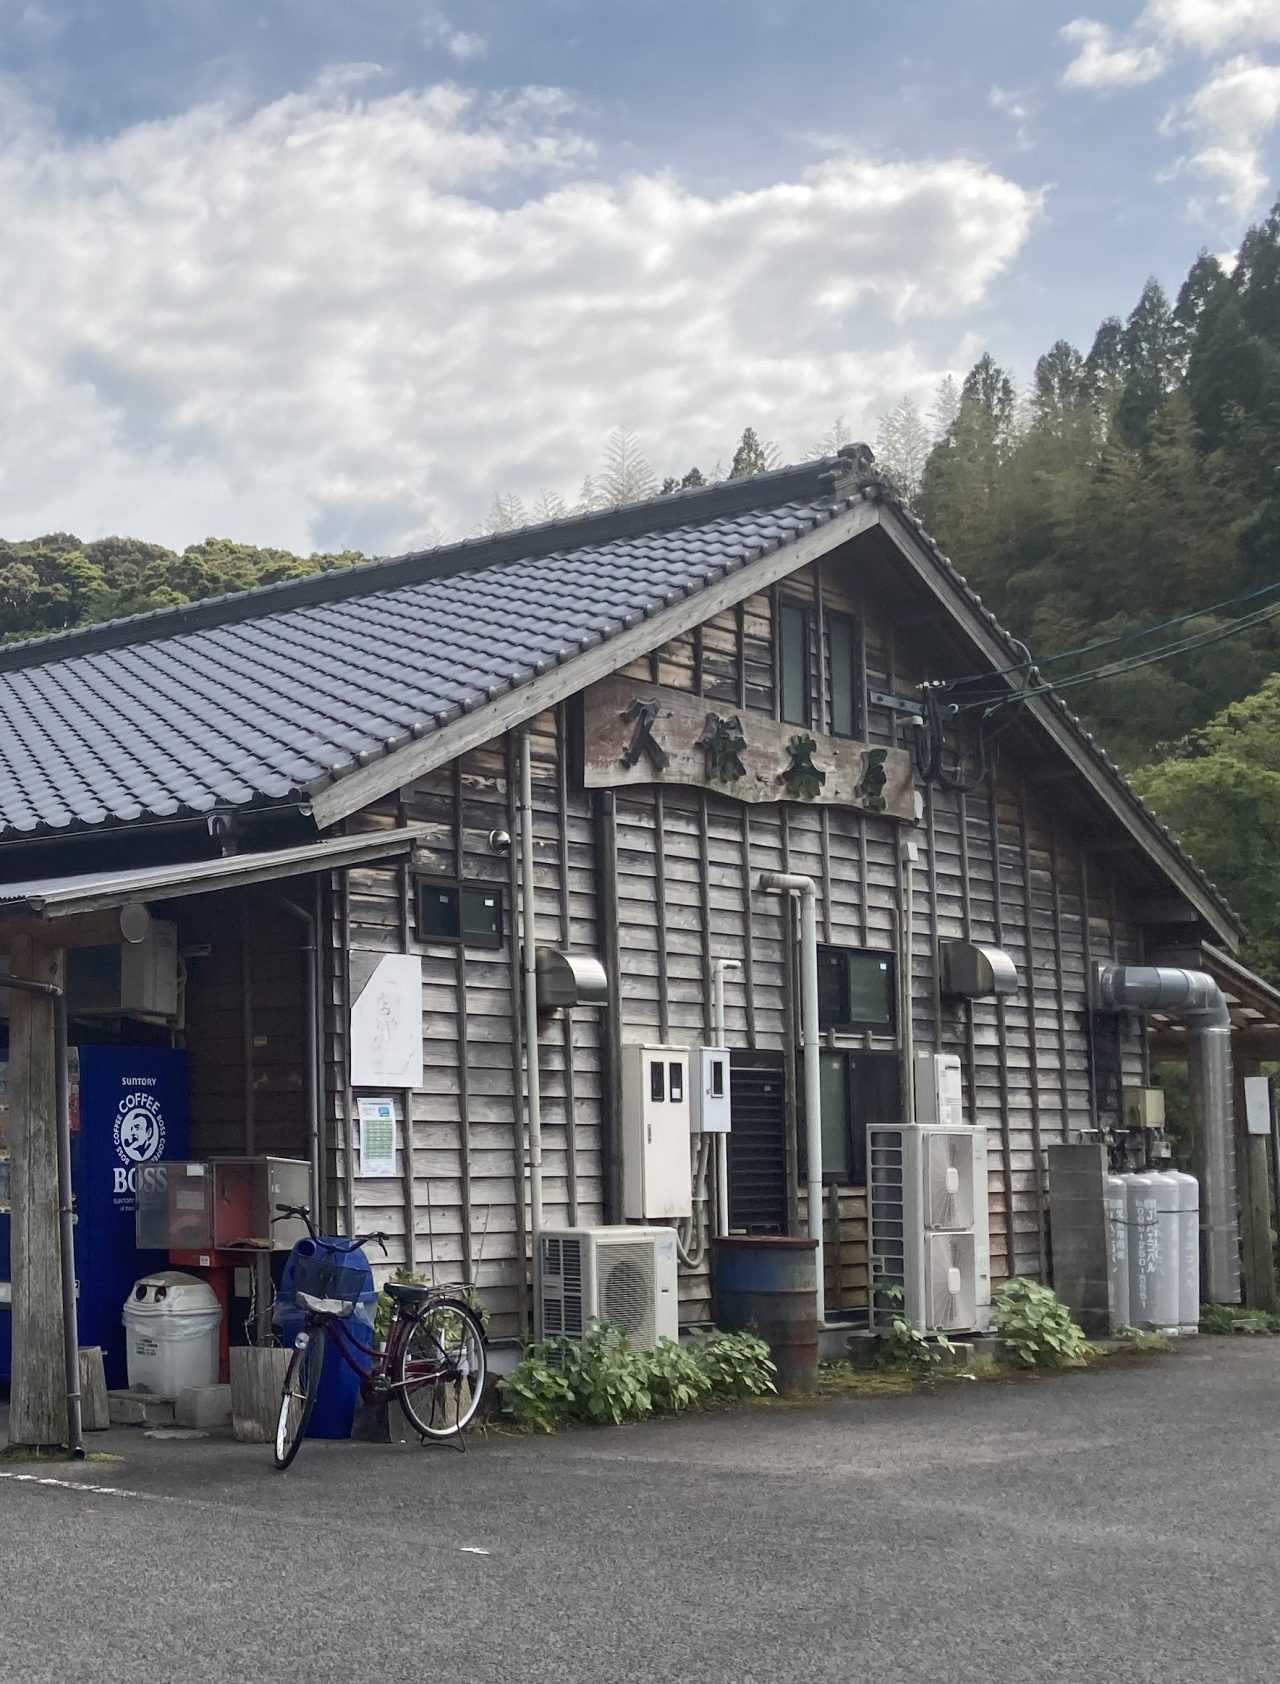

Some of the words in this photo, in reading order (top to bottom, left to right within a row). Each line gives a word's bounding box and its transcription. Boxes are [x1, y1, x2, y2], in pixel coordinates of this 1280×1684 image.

[121, 1077, 157, 1086] SUNTORY
[119, 1093, 160, 1114] COFFEE
[114, 1114, 123, 1145] COFFEE
[156, 1114, 166, 1136] BOSS
[116, 1146, 130, 1165] BOSS
[113, 1167, 168, 1193] BOSS
